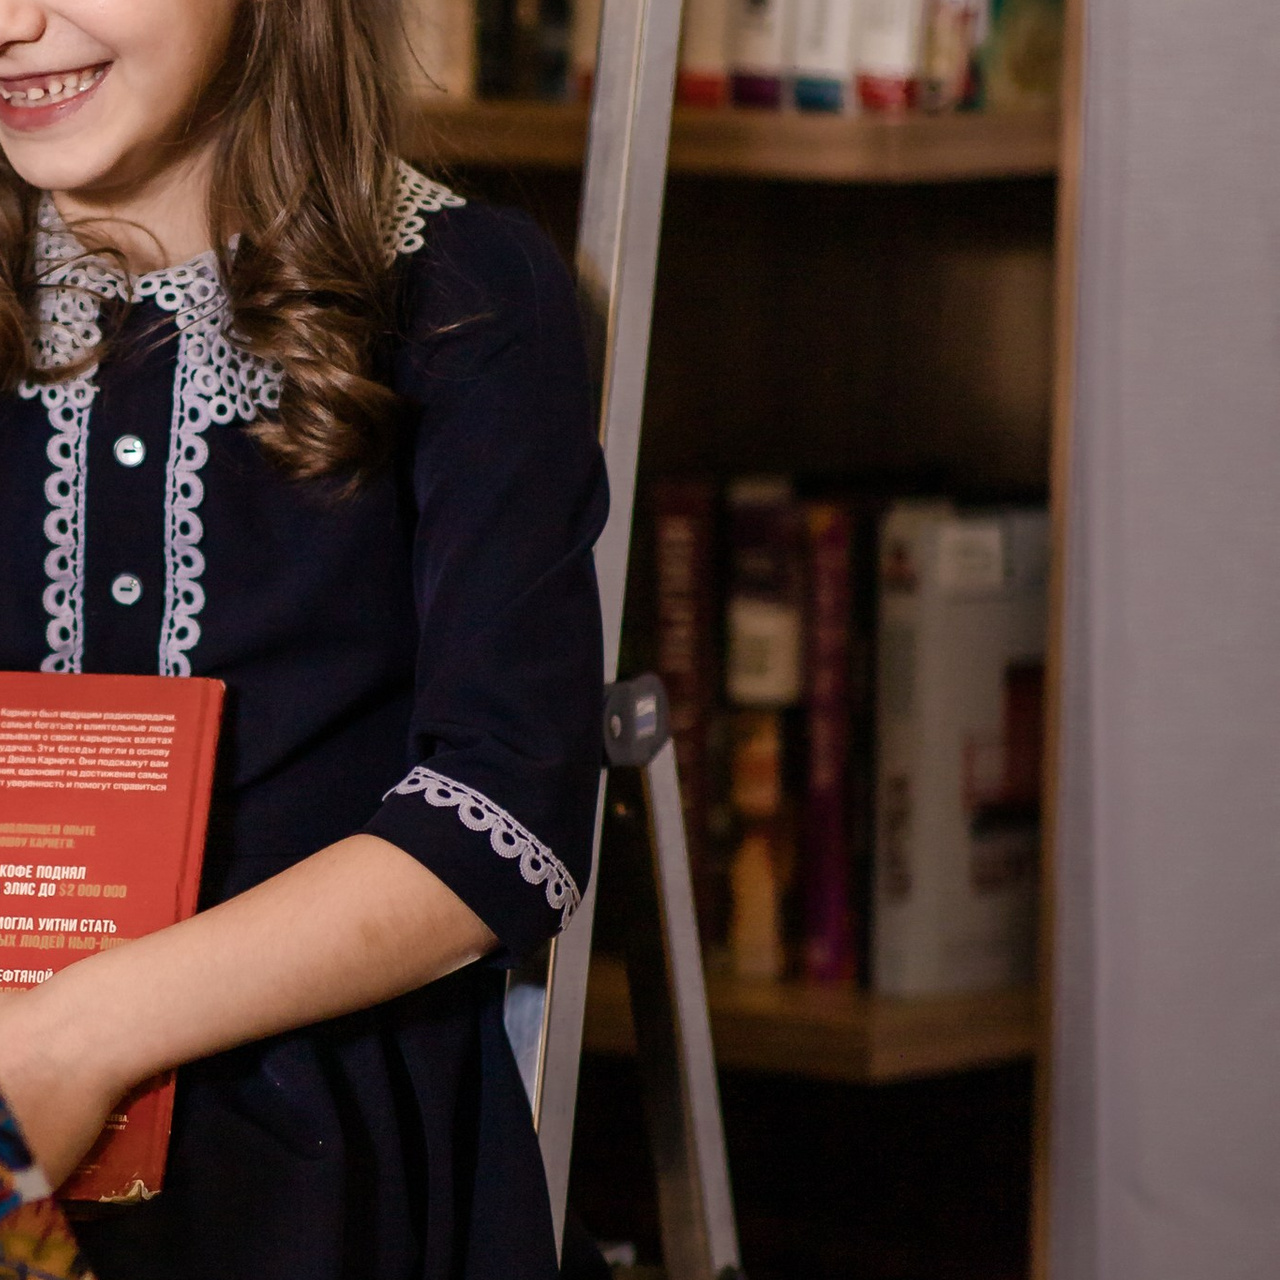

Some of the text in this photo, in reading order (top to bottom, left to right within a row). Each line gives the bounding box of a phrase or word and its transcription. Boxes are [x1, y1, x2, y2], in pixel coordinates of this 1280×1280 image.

[58, 746, 96, 755] беседы
[0, 864, 33, 878] КОФЕ
[36, 865, 86, 880] ПОДНЯЛ
[3, 881, 36, 895] ЭЛИС
[38, 882, 56, 897] ДО
[59, 883, 75, 897] $2
[77, 884, 101, 897] 000
[38, 917, 77, 932] УИТНИ
[79, 919, 117, 933] СТАТЬ
[19, 933, 65, 950] ЛЮДЕЙ
